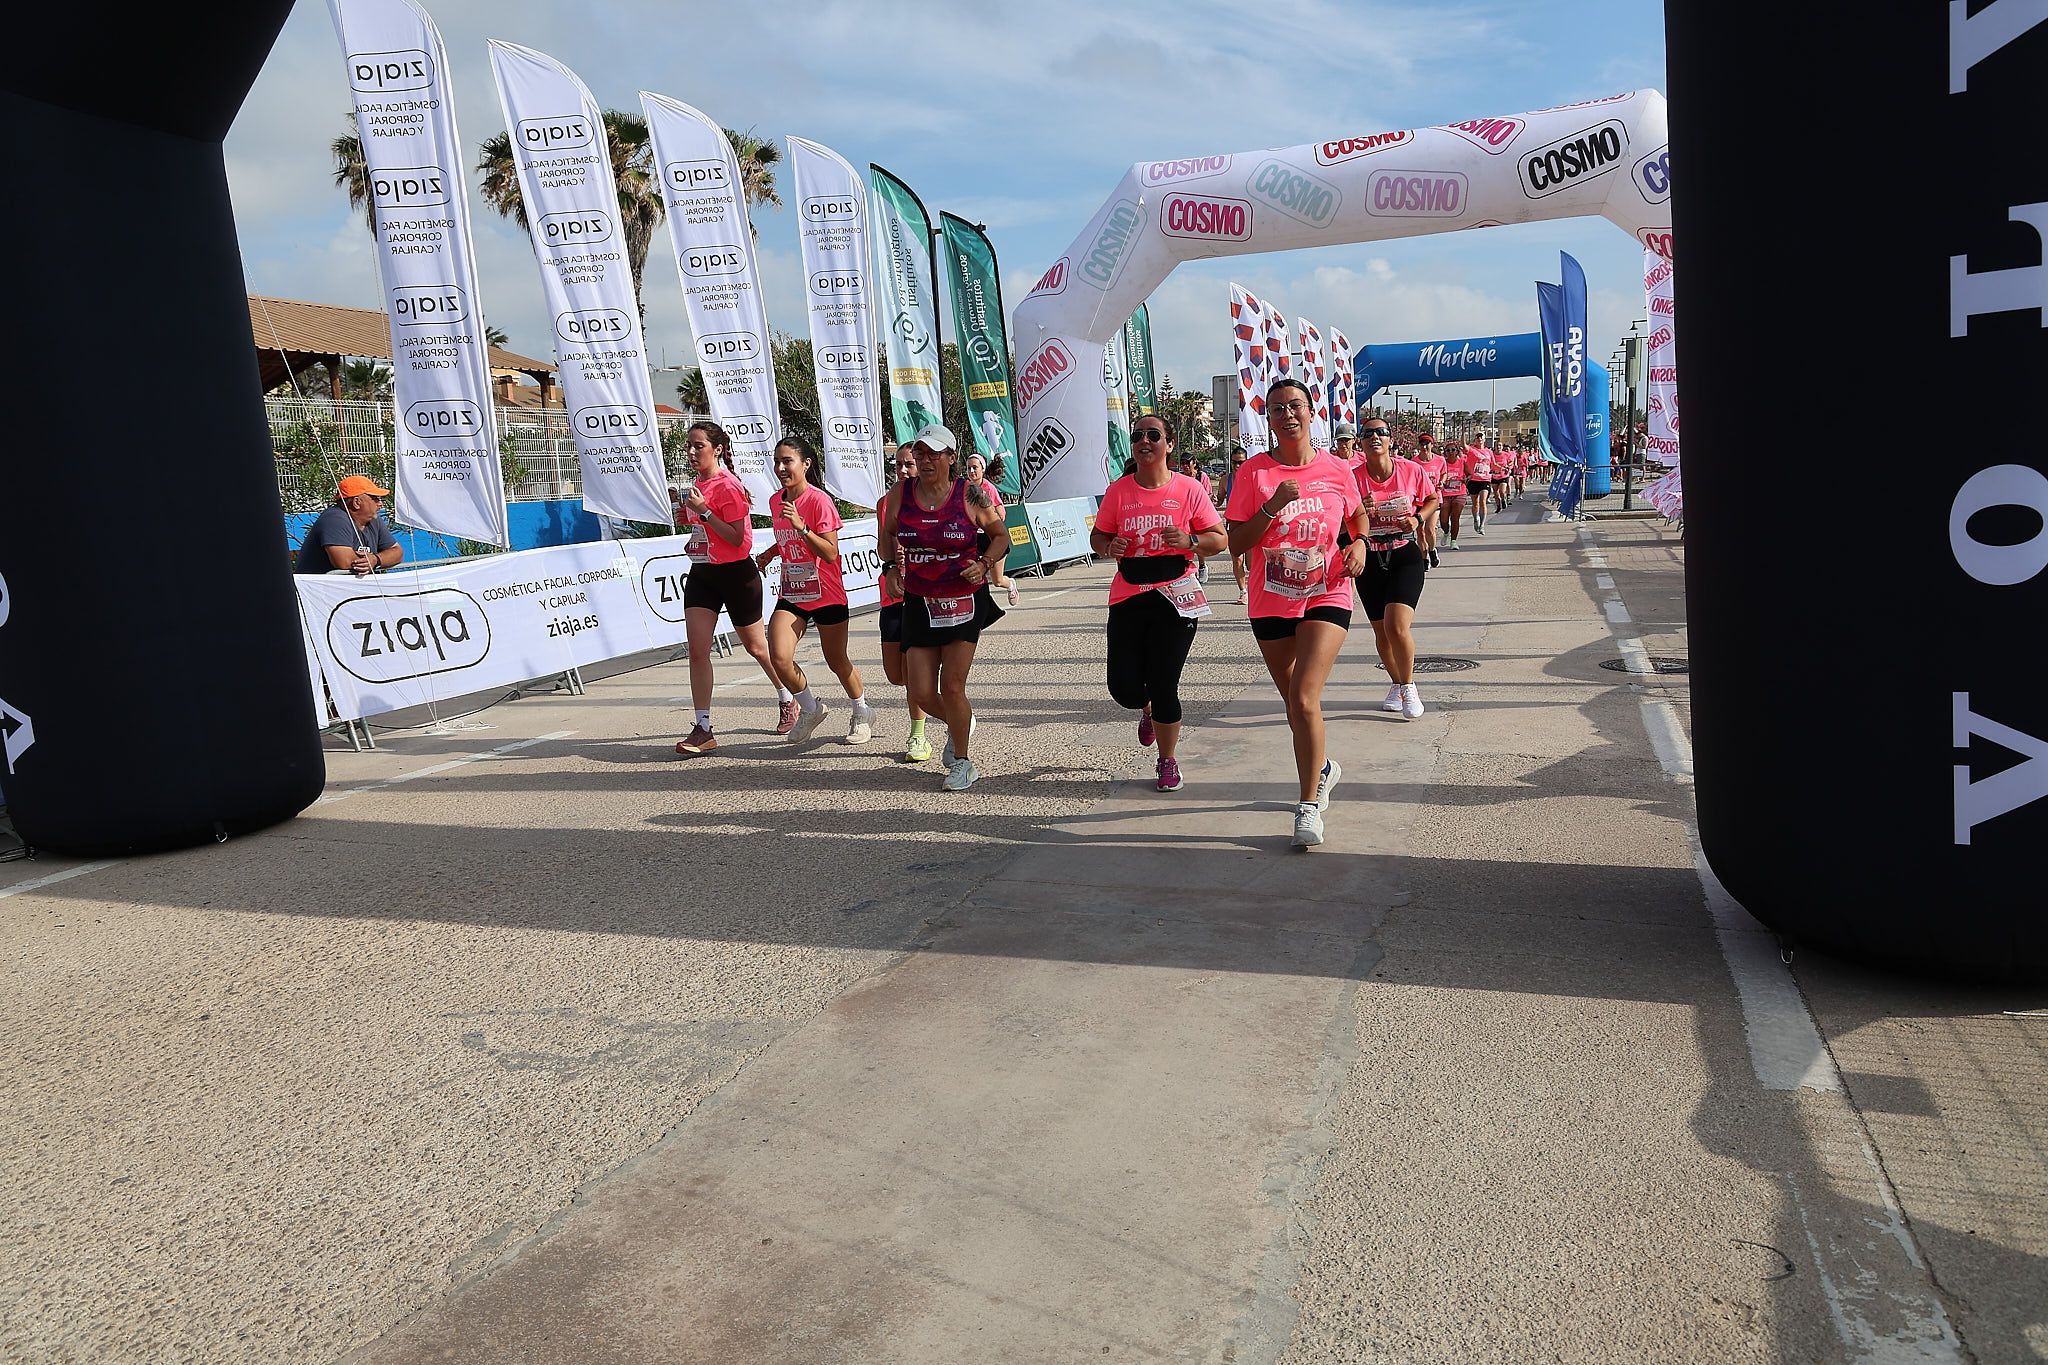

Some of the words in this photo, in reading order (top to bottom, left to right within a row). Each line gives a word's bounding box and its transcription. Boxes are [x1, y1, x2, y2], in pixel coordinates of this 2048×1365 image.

[1323, 131, 1406, 159] COSMO
[1528, 127, 1621, 190] COSMO
[1150, 156, 1225, 180] COSMO
[1256, 164, 1333, 222] COSMO
[1374, 176, 1460, 212] COSMO
[1169, 199, 1244, 236] COSMO
[1085, 206, 1140, 282] COSMO
[1418, 343, 1496, 377] Marlene
[1018, 346, 1068, 410] COSMO
[1022, 425, 1066, 490] COSMO
[1124, 515, 1174, 531] CARRERA
[1296, 520, 1317, 542] DE
[790, 544, 803, 560] DE
[842, 549, 881, 579] iaja
[482, 577, 542, 602] COSMÉTICA
[543, 575, 577, 591] FACIAL,
[578, 566, 623, 586] CORPORAL
[1284, 568, 1307, 580] 016
[539, 598, 548, 609] Y
[550, 592, 587, 608] CAPILAR
[1177, 592, 1195, 604] 016
[352, 608, 470, 660] ziaja
[547, 614, 599, 639] ziaja.es
